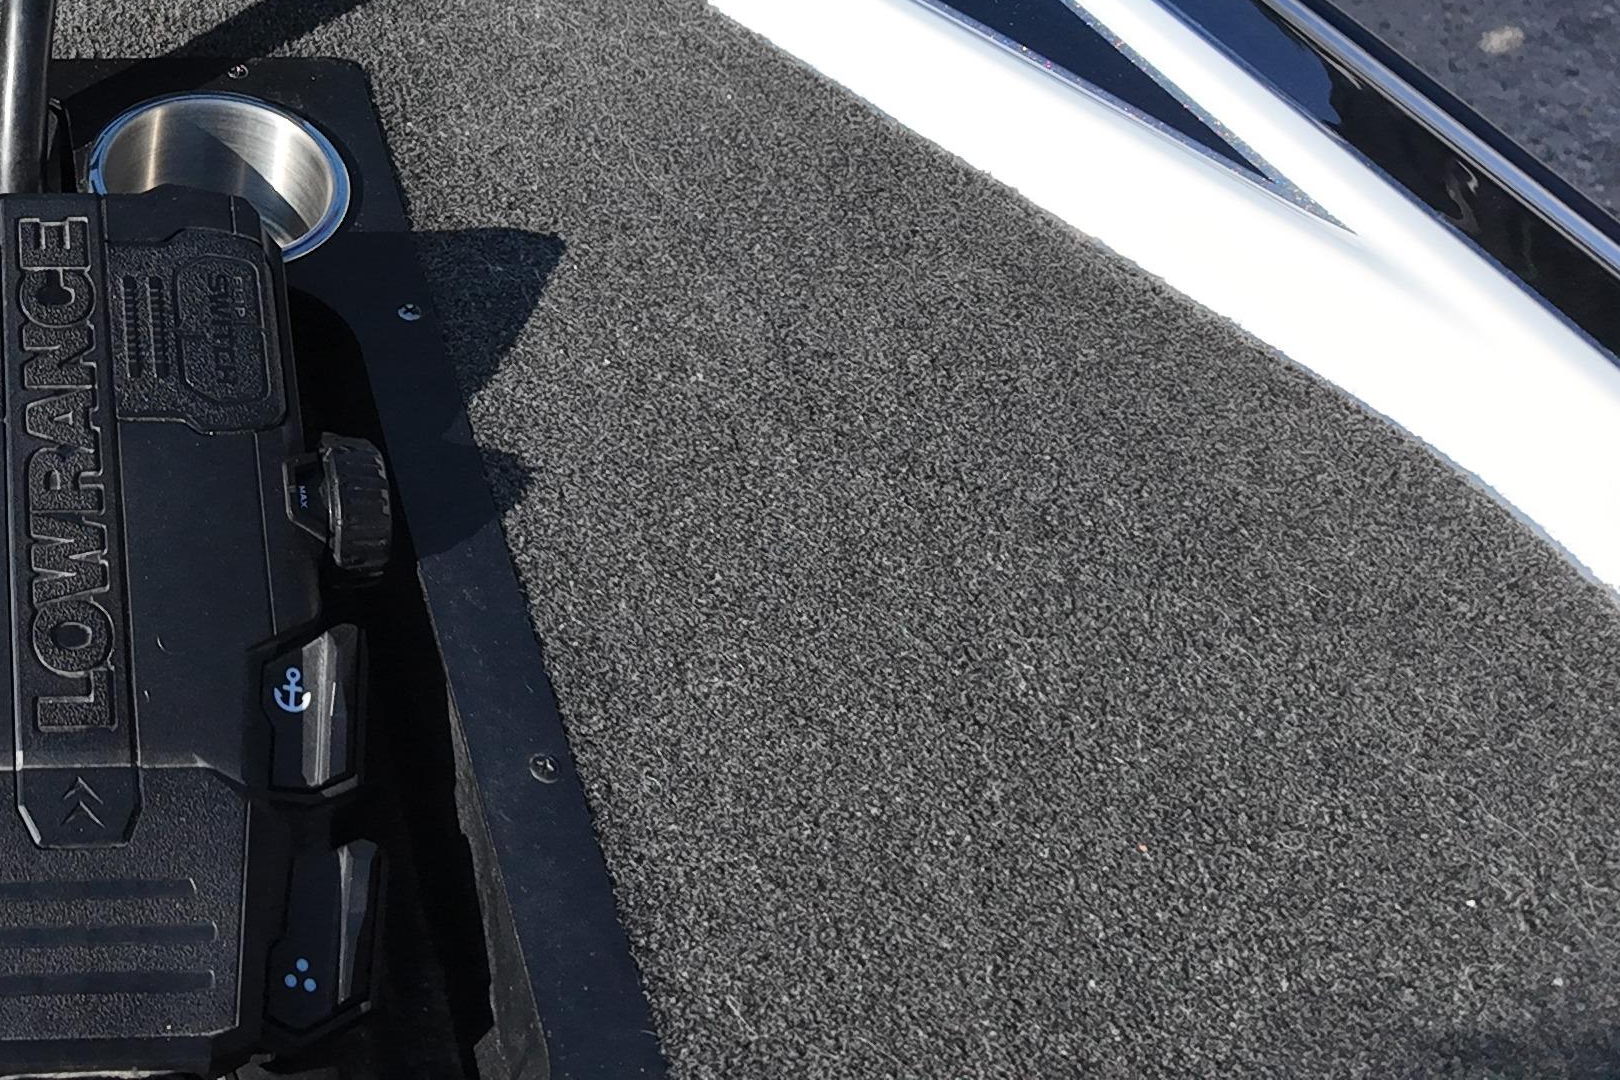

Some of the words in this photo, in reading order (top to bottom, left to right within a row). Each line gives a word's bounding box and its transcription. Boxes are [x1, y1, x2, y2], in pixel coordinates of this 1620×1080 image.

[232, 275, 246, 318] FLIP
[18, 216, 118, 734] LOWRANCE
[299, 483, 309, 510] MAX
